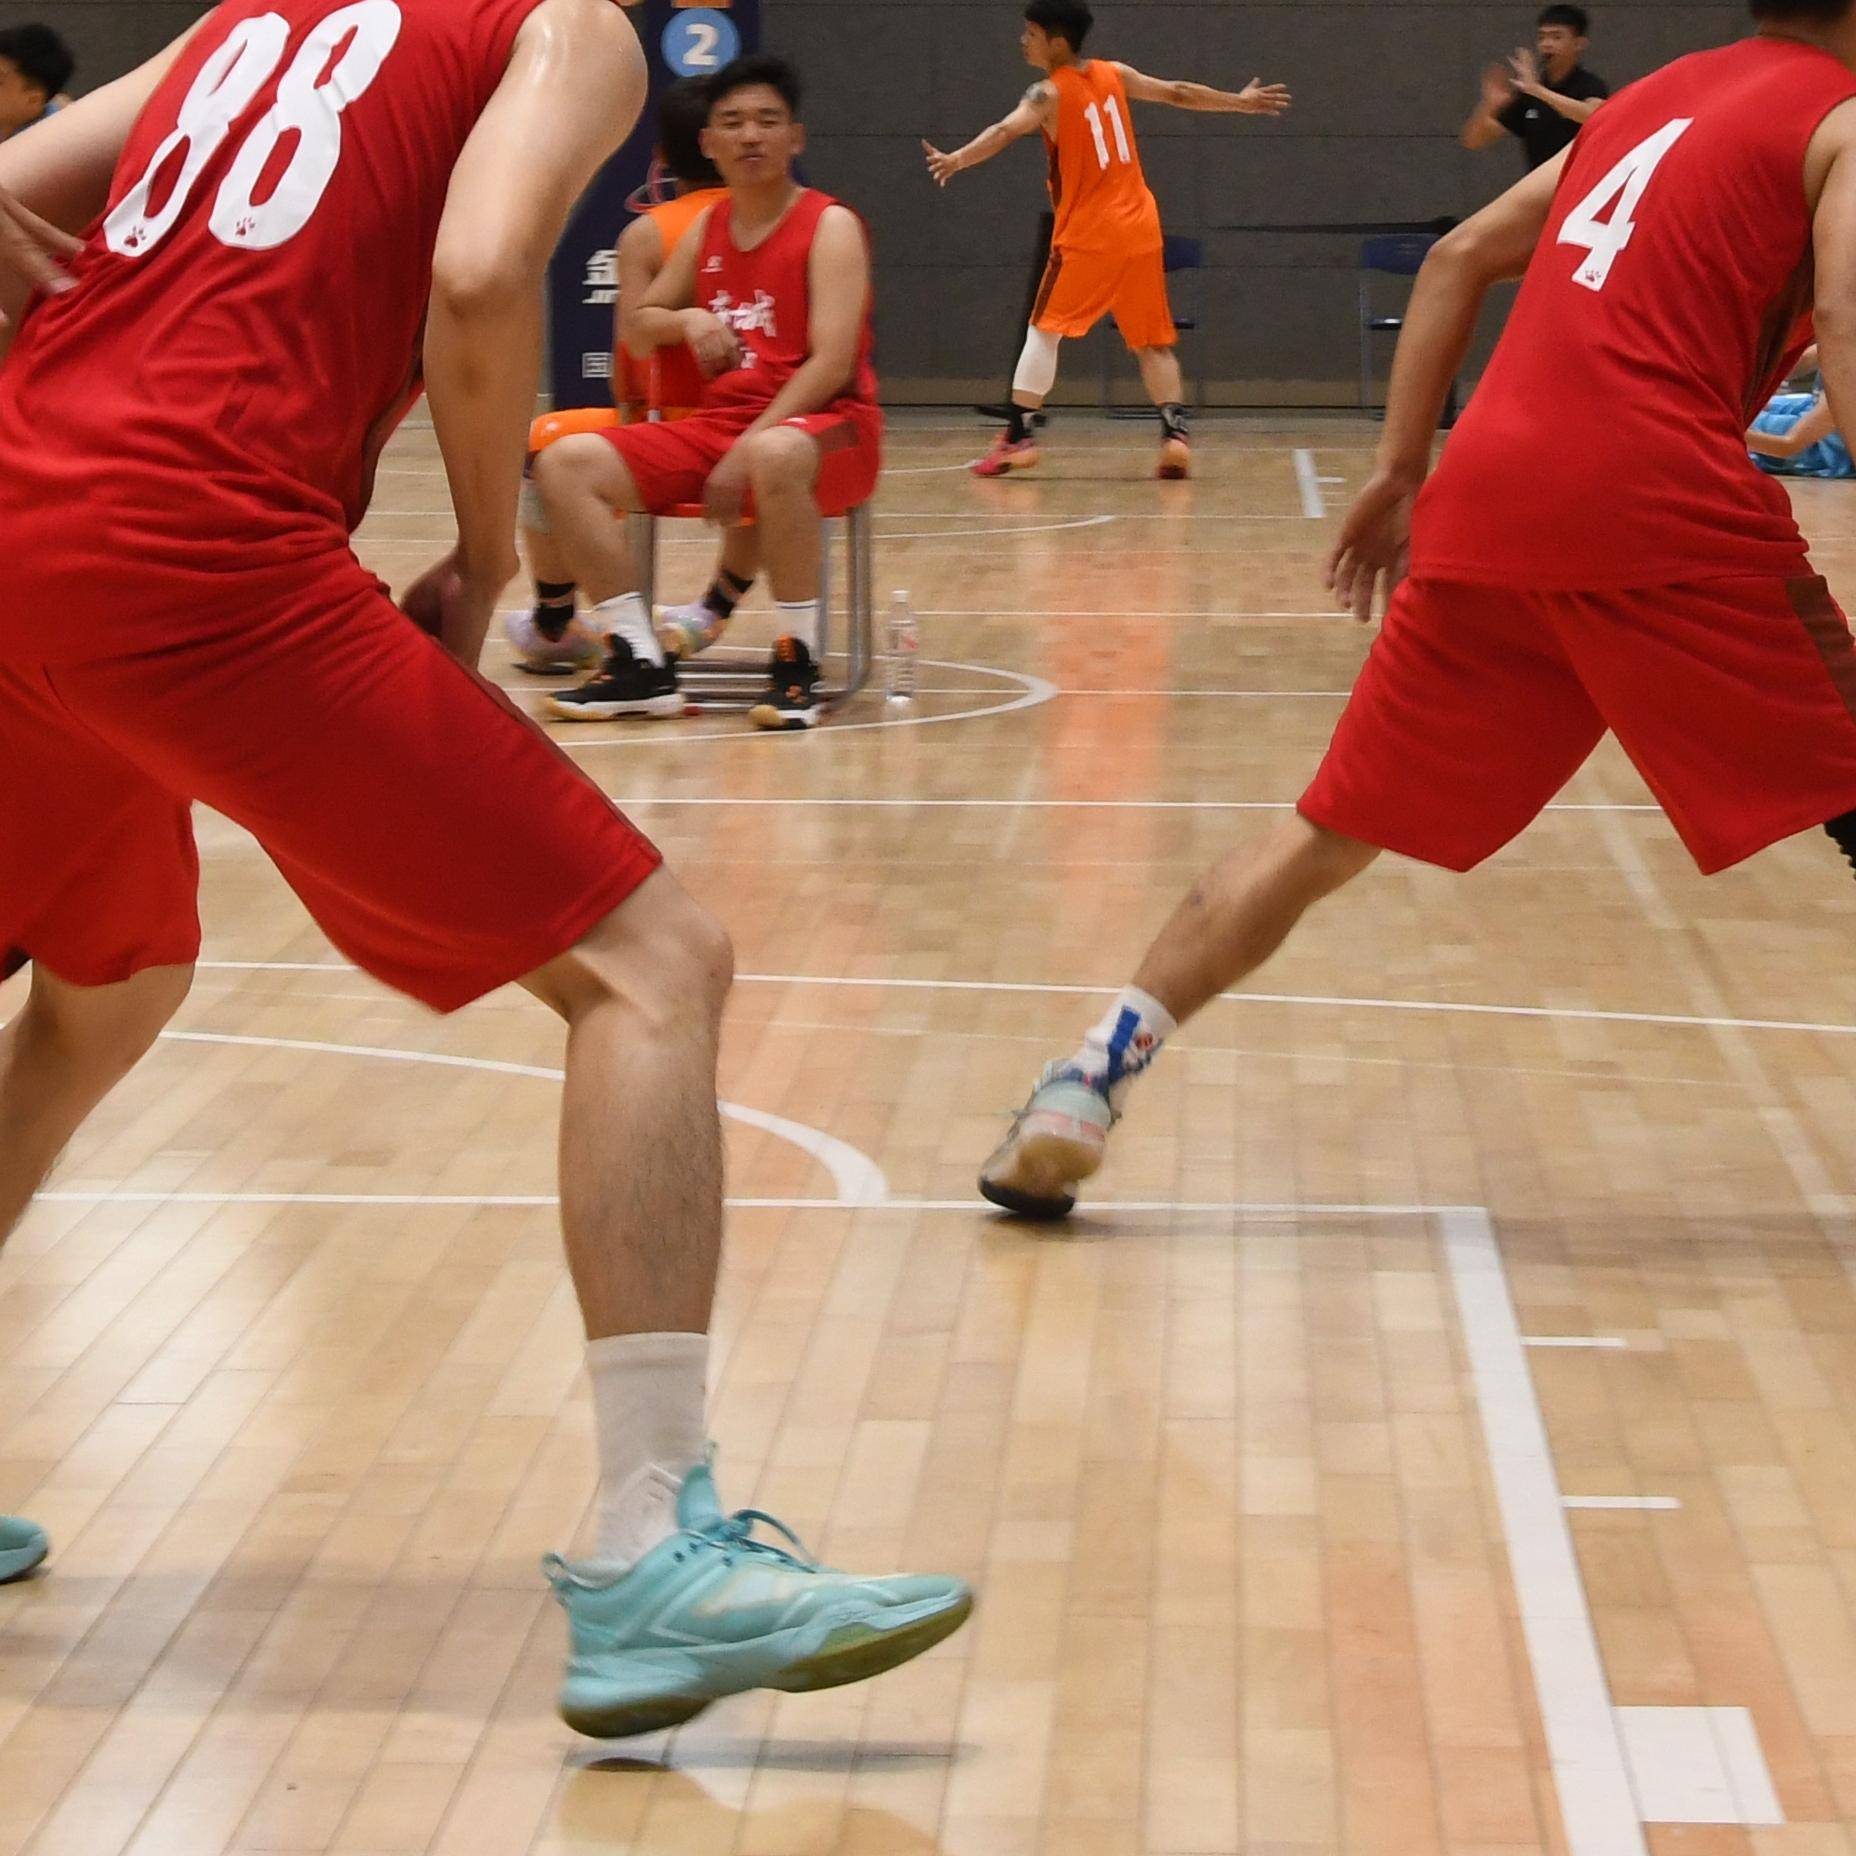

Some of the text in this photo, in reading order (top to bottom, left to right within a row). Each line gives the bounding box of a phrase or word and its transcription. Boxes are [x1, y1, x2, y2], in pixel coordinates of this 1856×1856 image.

[681, 22, 721, 67] 2
[1083, 93, 1132, 171] 11
[1555, 116, 1695, 293] 4
